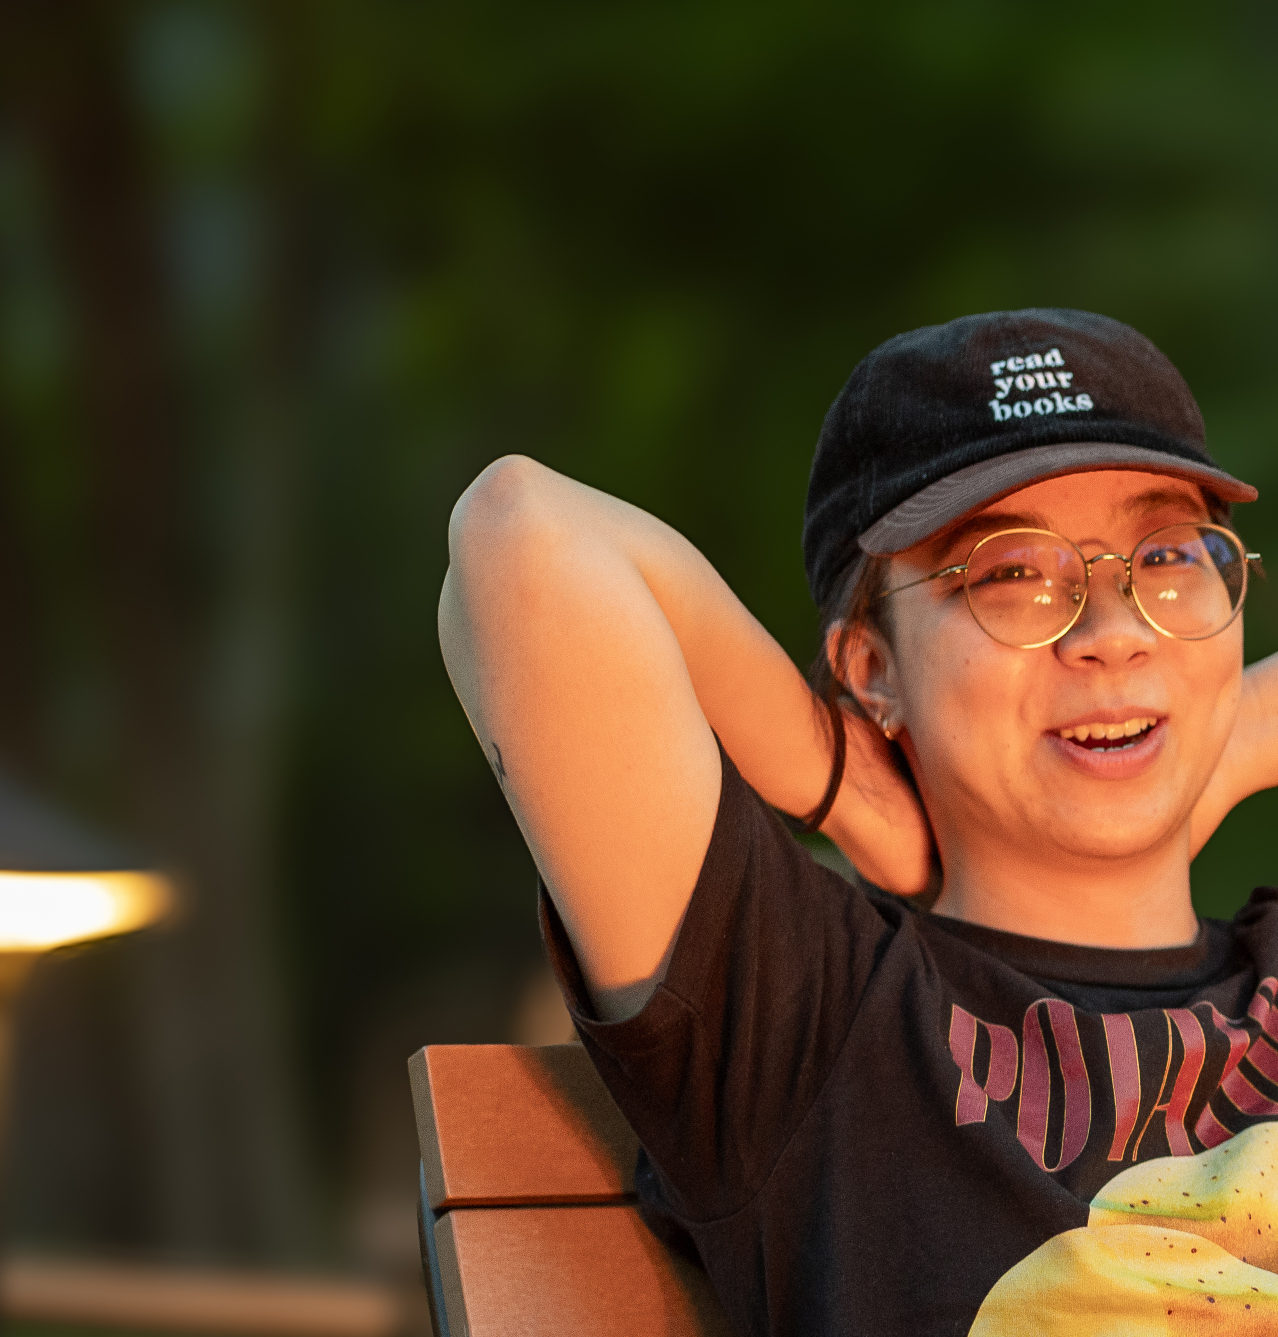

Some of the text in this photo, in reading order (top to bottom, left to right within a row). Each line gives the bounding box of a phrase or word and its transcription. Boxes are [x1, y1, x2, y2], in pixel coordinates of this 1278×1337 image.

[989, 348, 1066, 376] read
[993, 371, 1074, 399] your
[988, 391, 1094, 422] books
